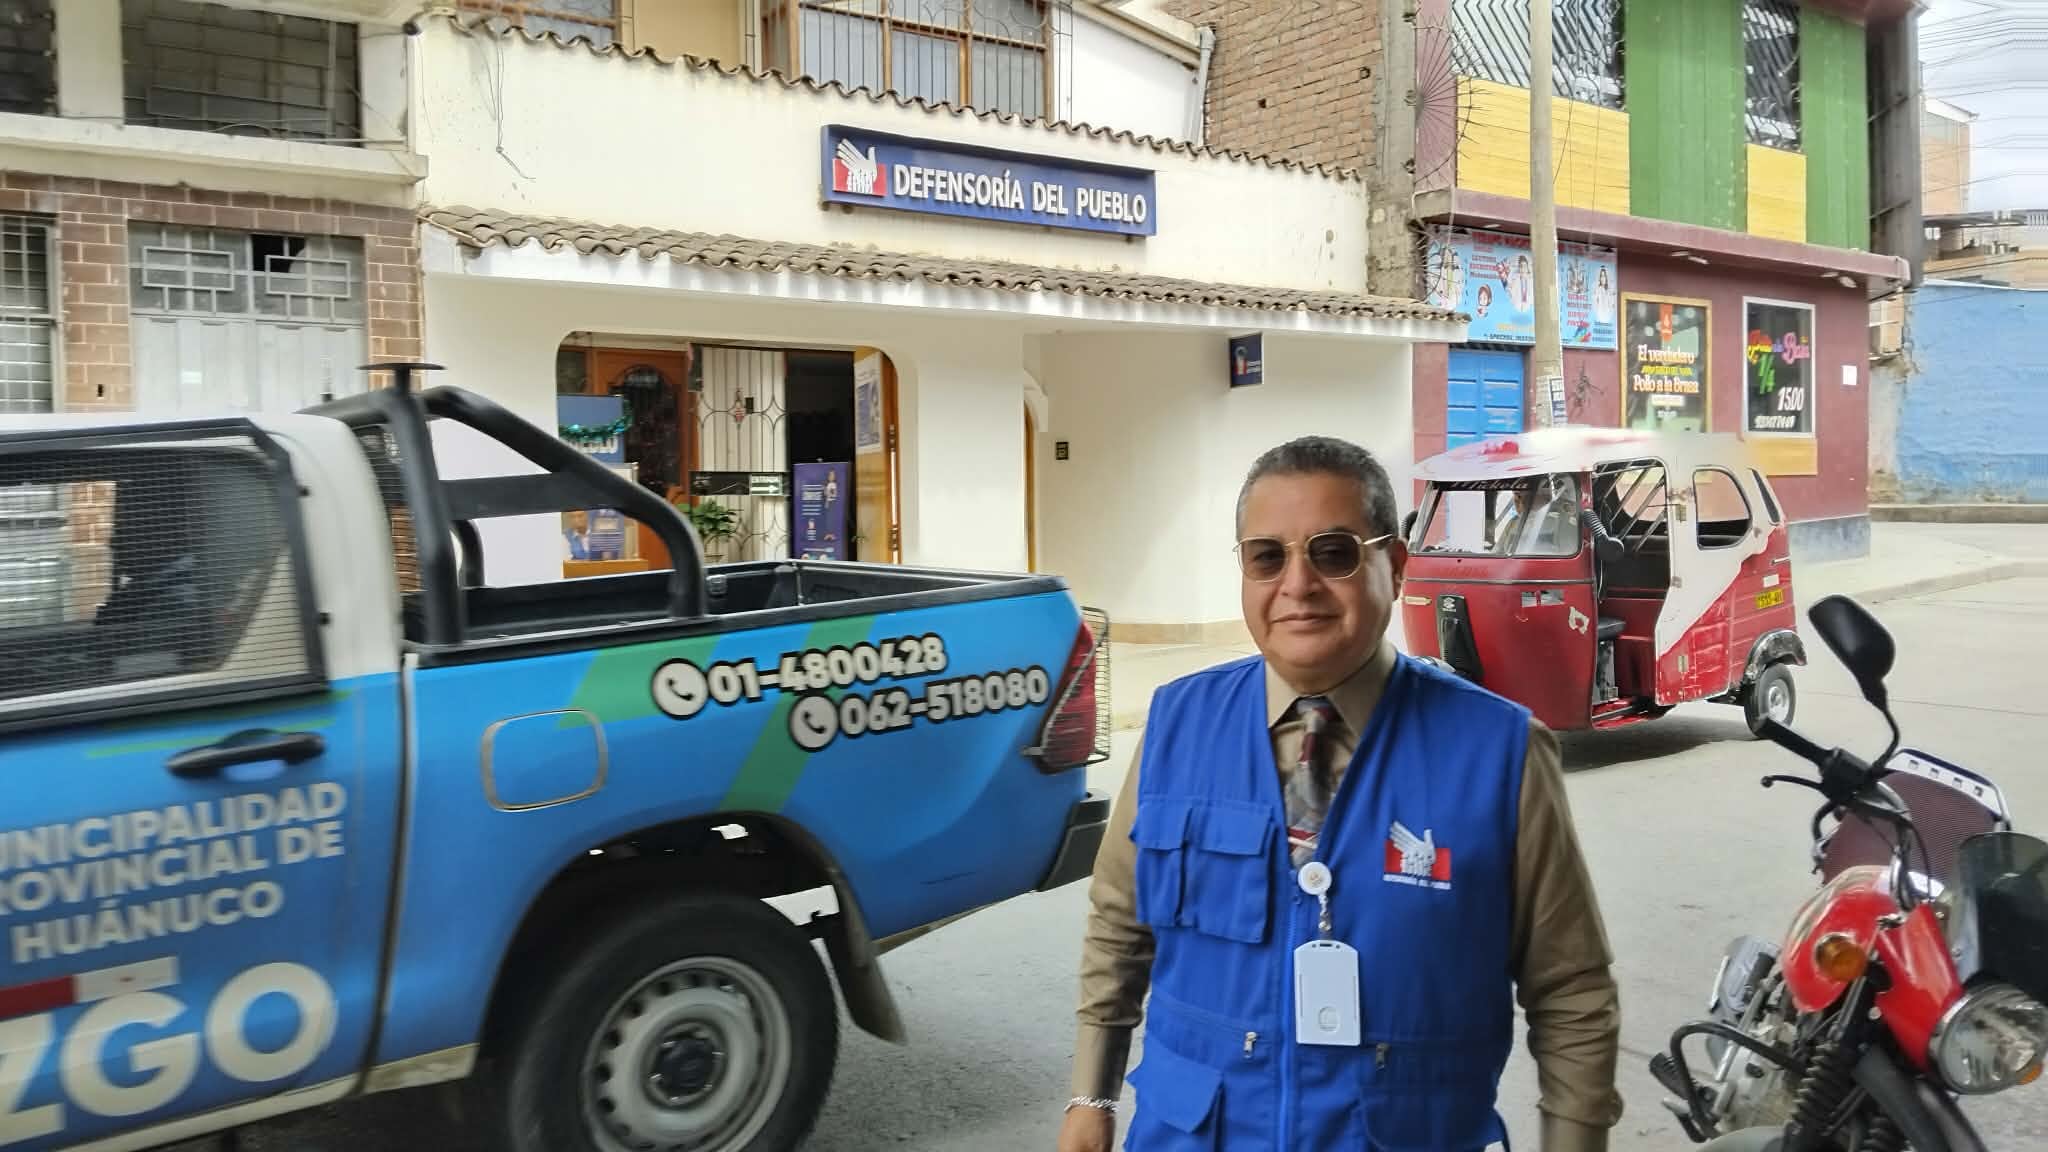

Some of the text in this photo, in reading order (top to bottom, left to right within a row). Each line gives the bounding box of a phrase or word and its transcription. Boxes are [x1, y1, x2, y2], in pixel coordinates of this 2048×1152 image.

[893, 163, 1147, 224] DEFENSORÍA DEL PUEBLO
[1633, 374, 1656, 392] Pollo
[707, 633, 947, 704] 01-4800428
[839, 666, 1050, 736] 062-518080
[277, 820, 345, 864] DE
[11, 880, 284, 963] HUÁNUCO
